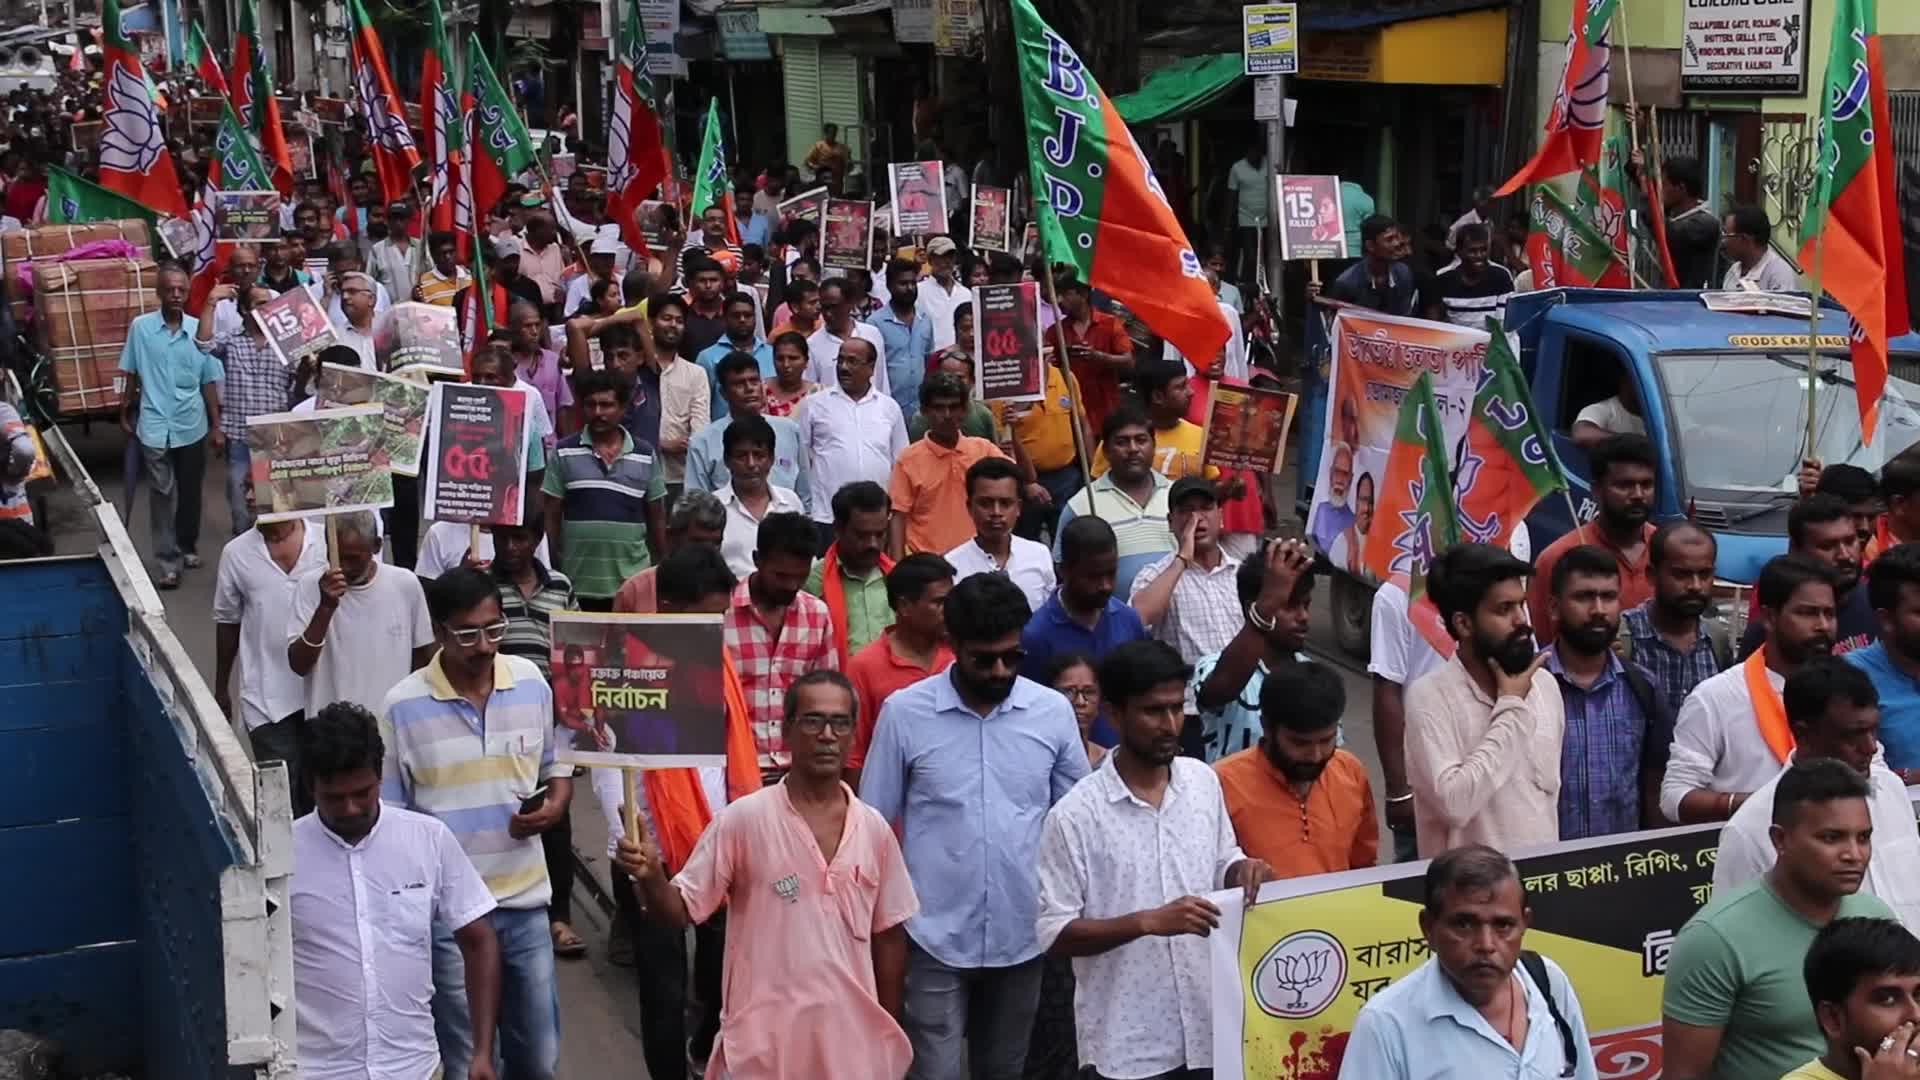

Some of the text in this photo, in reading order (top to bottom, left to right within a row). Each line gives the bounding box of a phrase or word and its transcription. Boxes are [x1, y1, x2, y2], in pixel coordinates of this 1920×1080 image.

[1688, 20, 1729, 30] COLLAPSIBLE
[1752, 19, 1781, 28] ROLLING
[1758, 32, 1776, 42] STEEL
[1747, 46, 1765, 56] STAIR
[1765, 46, 1783, 55] CASES
[1706, 60, 1772, 71] DECORATIVE RAILINGS
[1285, 192, 1315, 218] 15
[1288, 219, 1317, 227] KILLED
[267, 308, 298, 334] 15
[1731, 336, 1849, 346] GOODS CARIAGE
[444, 444, 491, 480] ৫৫
[623, 668, 669, 681] পঞ্চায়েত
[590, 680, 669, 710] নির্বাচন
[1565, 862, 1619, 890] ছাপ্পা,
[1624, 849, 1688, 879] রিগিং,
[1689, 882, 1713, 904] রা
[1353, 936, 1430, 969] বারাস
